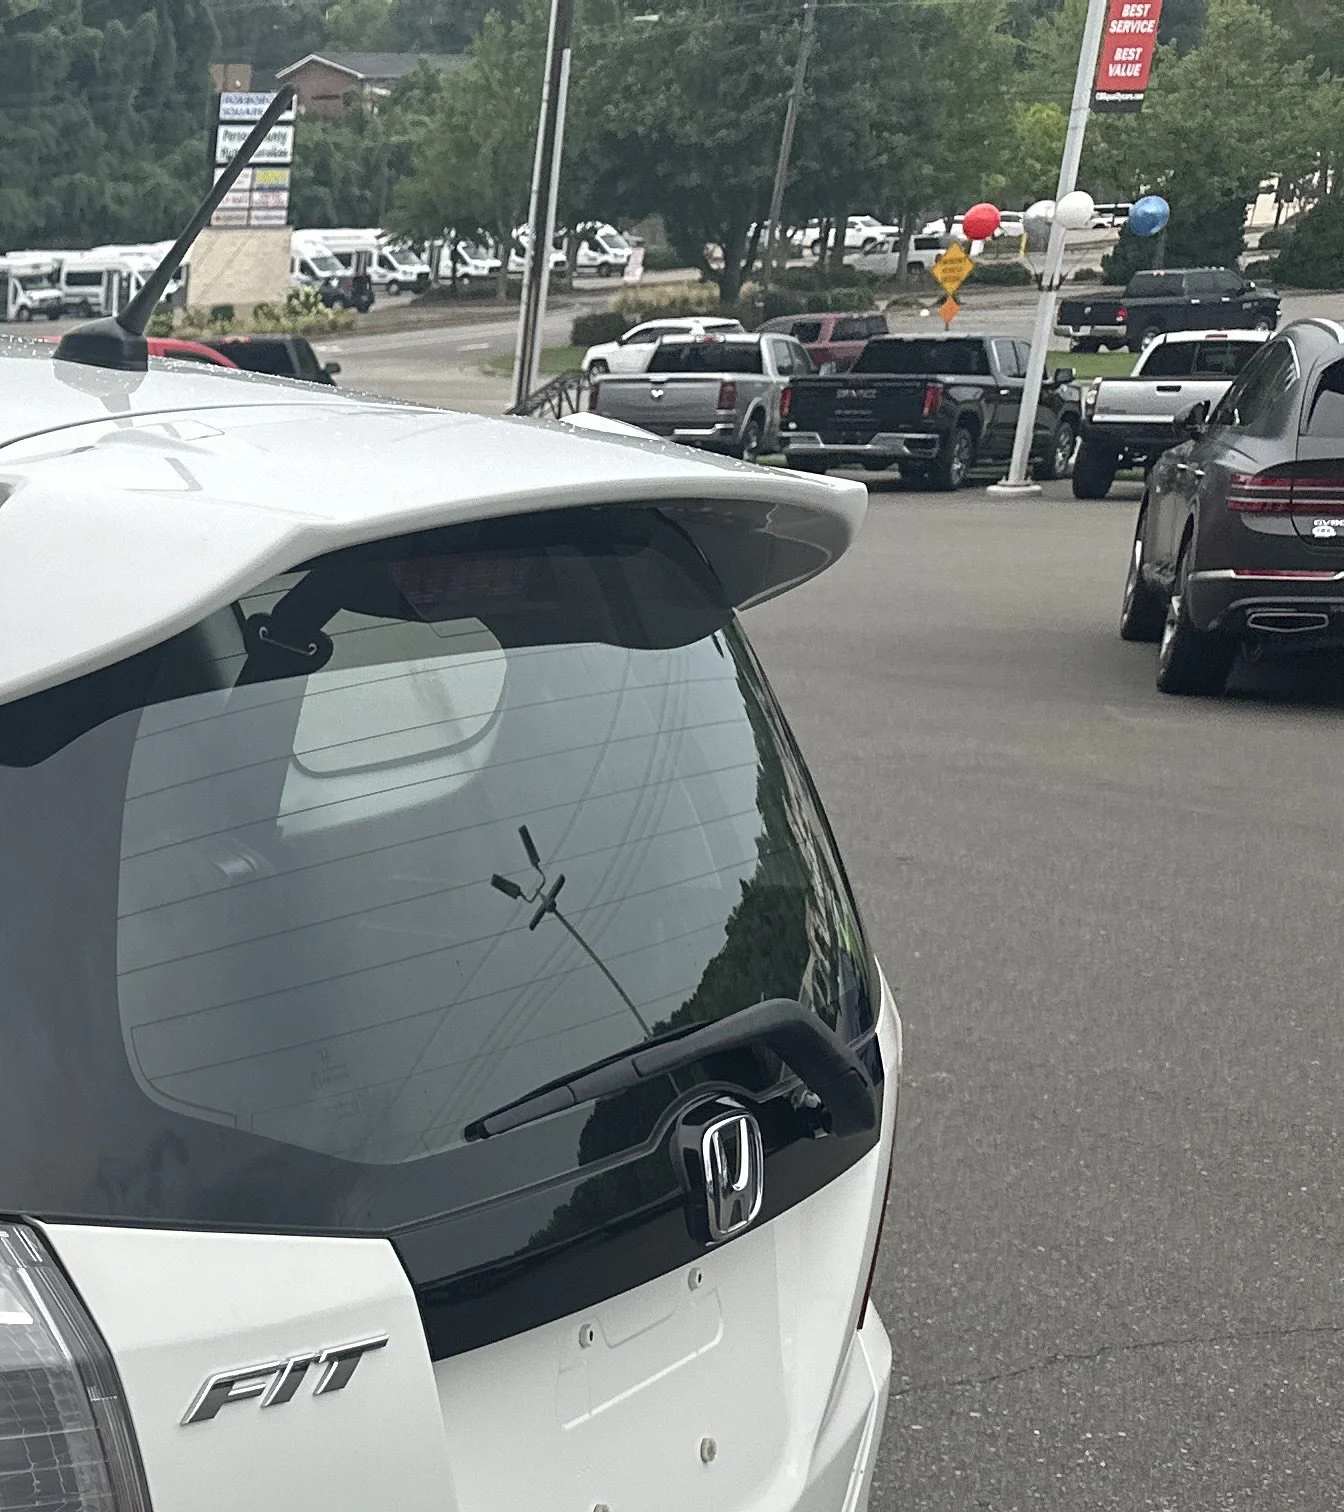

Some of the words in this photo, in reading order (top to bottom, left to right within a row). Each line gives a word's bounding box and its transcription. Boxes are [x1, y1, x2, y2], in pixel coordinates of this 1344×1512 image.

[1121, 4, 1151, 17] BEST
[1109, 20, 1156, 34] SERVICE
[1114, 48, 1143, 61] BEST
[1108, 63, 1143, 77] VALUE
[180, 1333, 390, 1425] FIT
